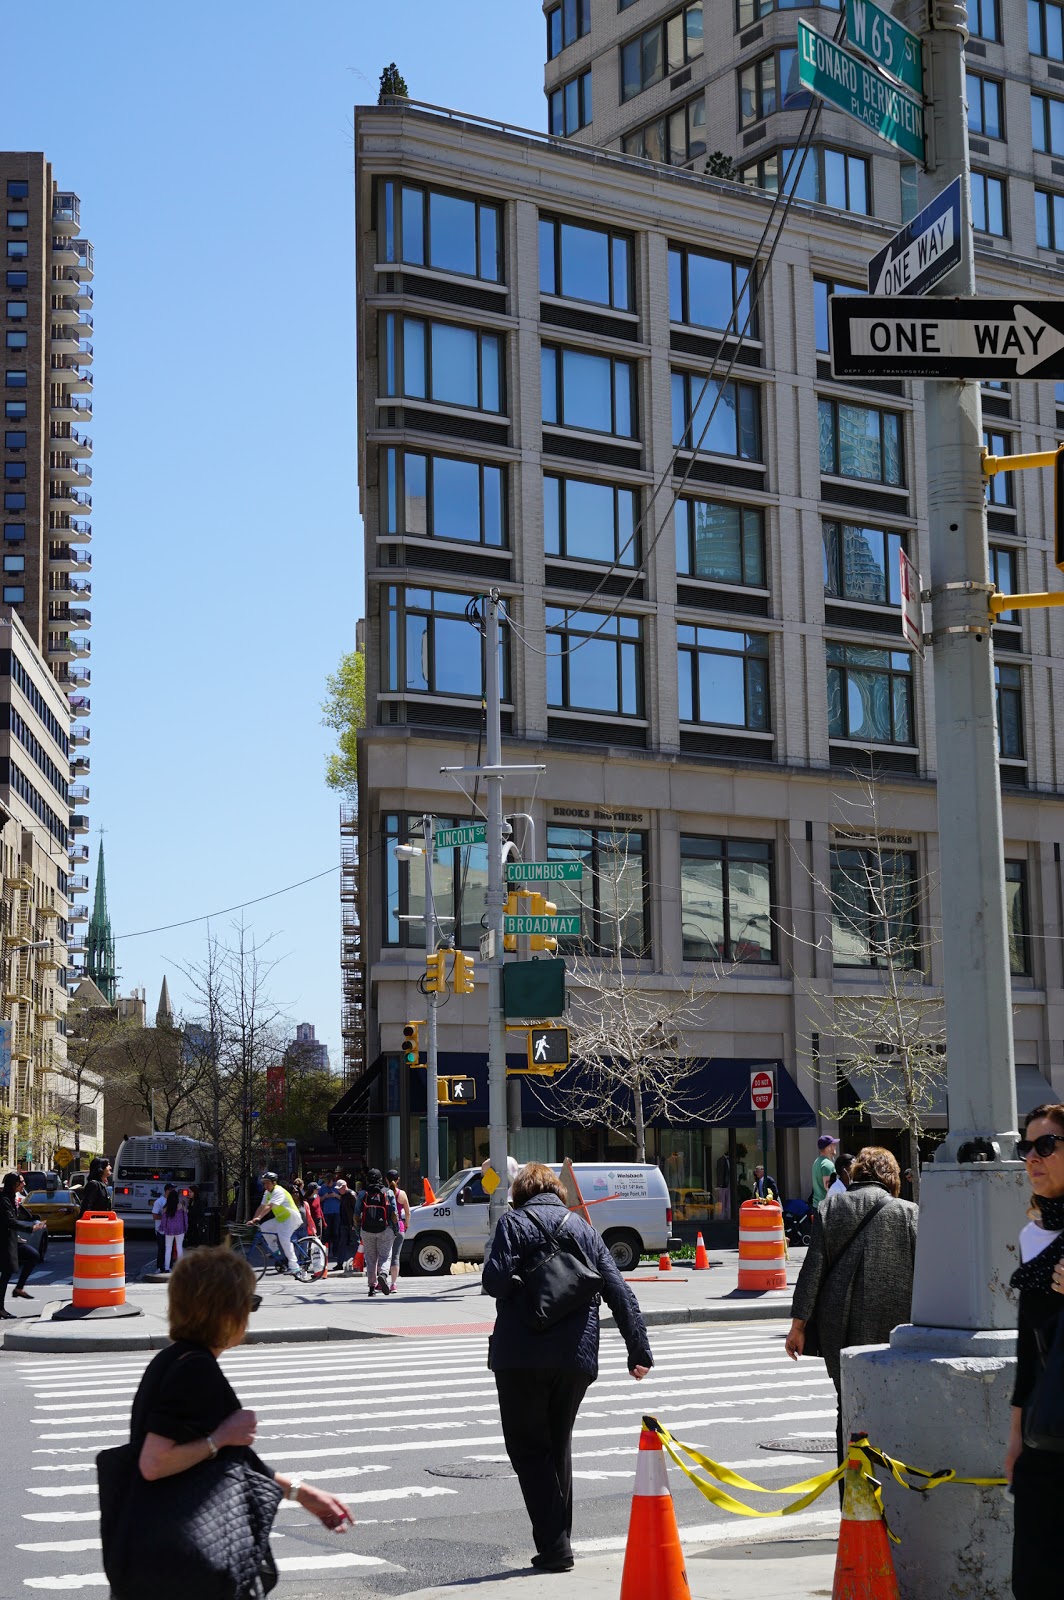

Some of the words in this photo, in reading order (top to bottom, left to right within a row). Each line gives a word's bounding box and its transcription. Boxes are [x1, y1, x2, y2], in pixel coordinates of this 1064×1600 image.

[853, 0, 868, 46] W
[871, 14, 894, 66] 65
[904, 36, 917, 64] ST
[802, 27, 857, 94] LEONARD
[862, 69, 923, 139] BERNSTEIN
[851, 97, 880, 129] PLACE
[885, 250, 911, 295] ONE
[917, 217, 948, 270] WAY
[870, 322, 941, 354] ONE
[973, 324, 1047, 356] WAY
[553, 807, 589, 818] BROOKS
[595, 810, 643, 822] BROTHERS
[437, 829, 475, 847] LINCOLN
[475, 827, 485, 837] SQ
[508, 864, 564, 880] COLUMBUS
[568, 864, 580, 873] AV
[508, 917, 575, 933] BROADWAY
[433, 1207, 451, 1217] 205
